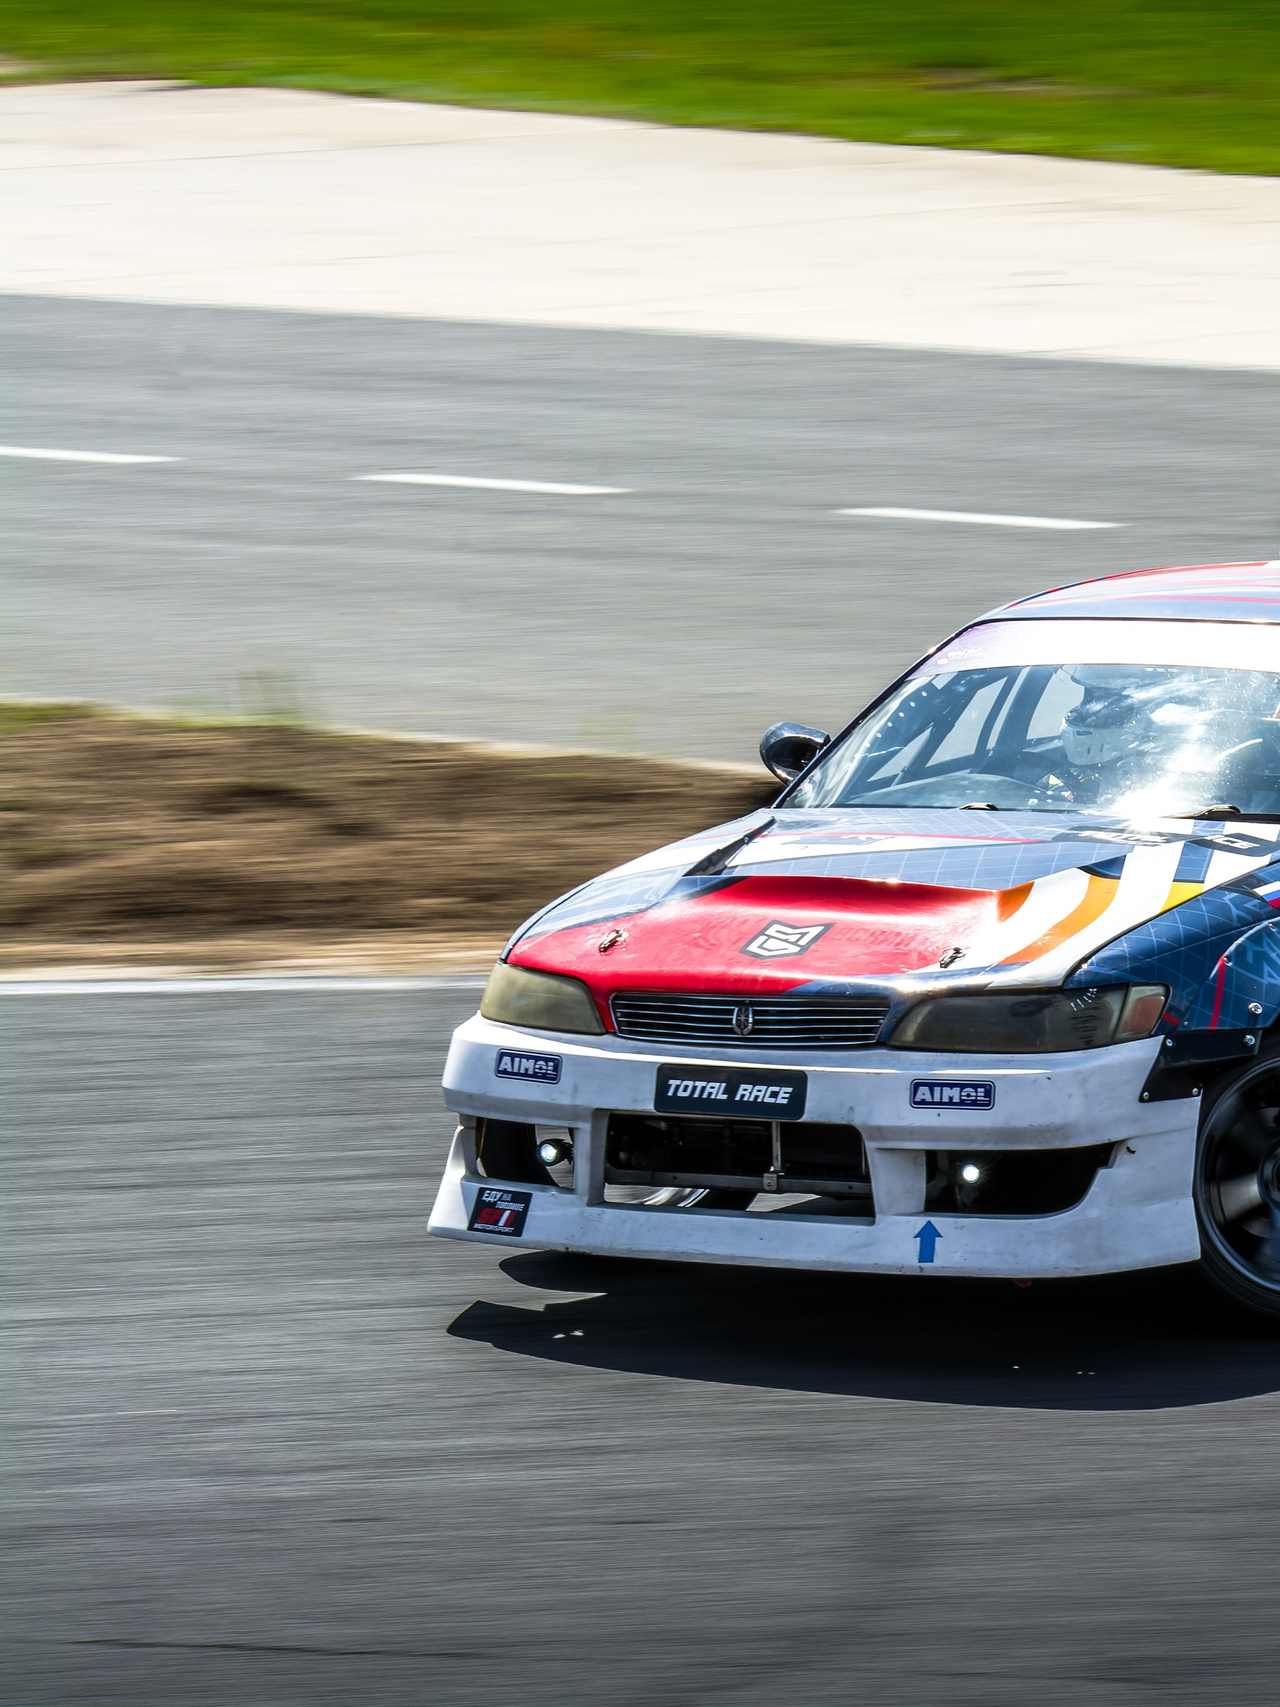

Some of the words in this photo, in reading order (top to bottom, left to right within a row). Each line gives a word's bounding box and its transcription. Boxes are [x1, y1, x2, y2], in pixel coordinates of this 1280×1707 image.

[498, 1056, 557, 1078] AIMOL
[667, 1079, 728, 1100] TOTAL
[734, 1084, 793, 1104] RACE
[914, 1086, 989, 1104] AIMOL
